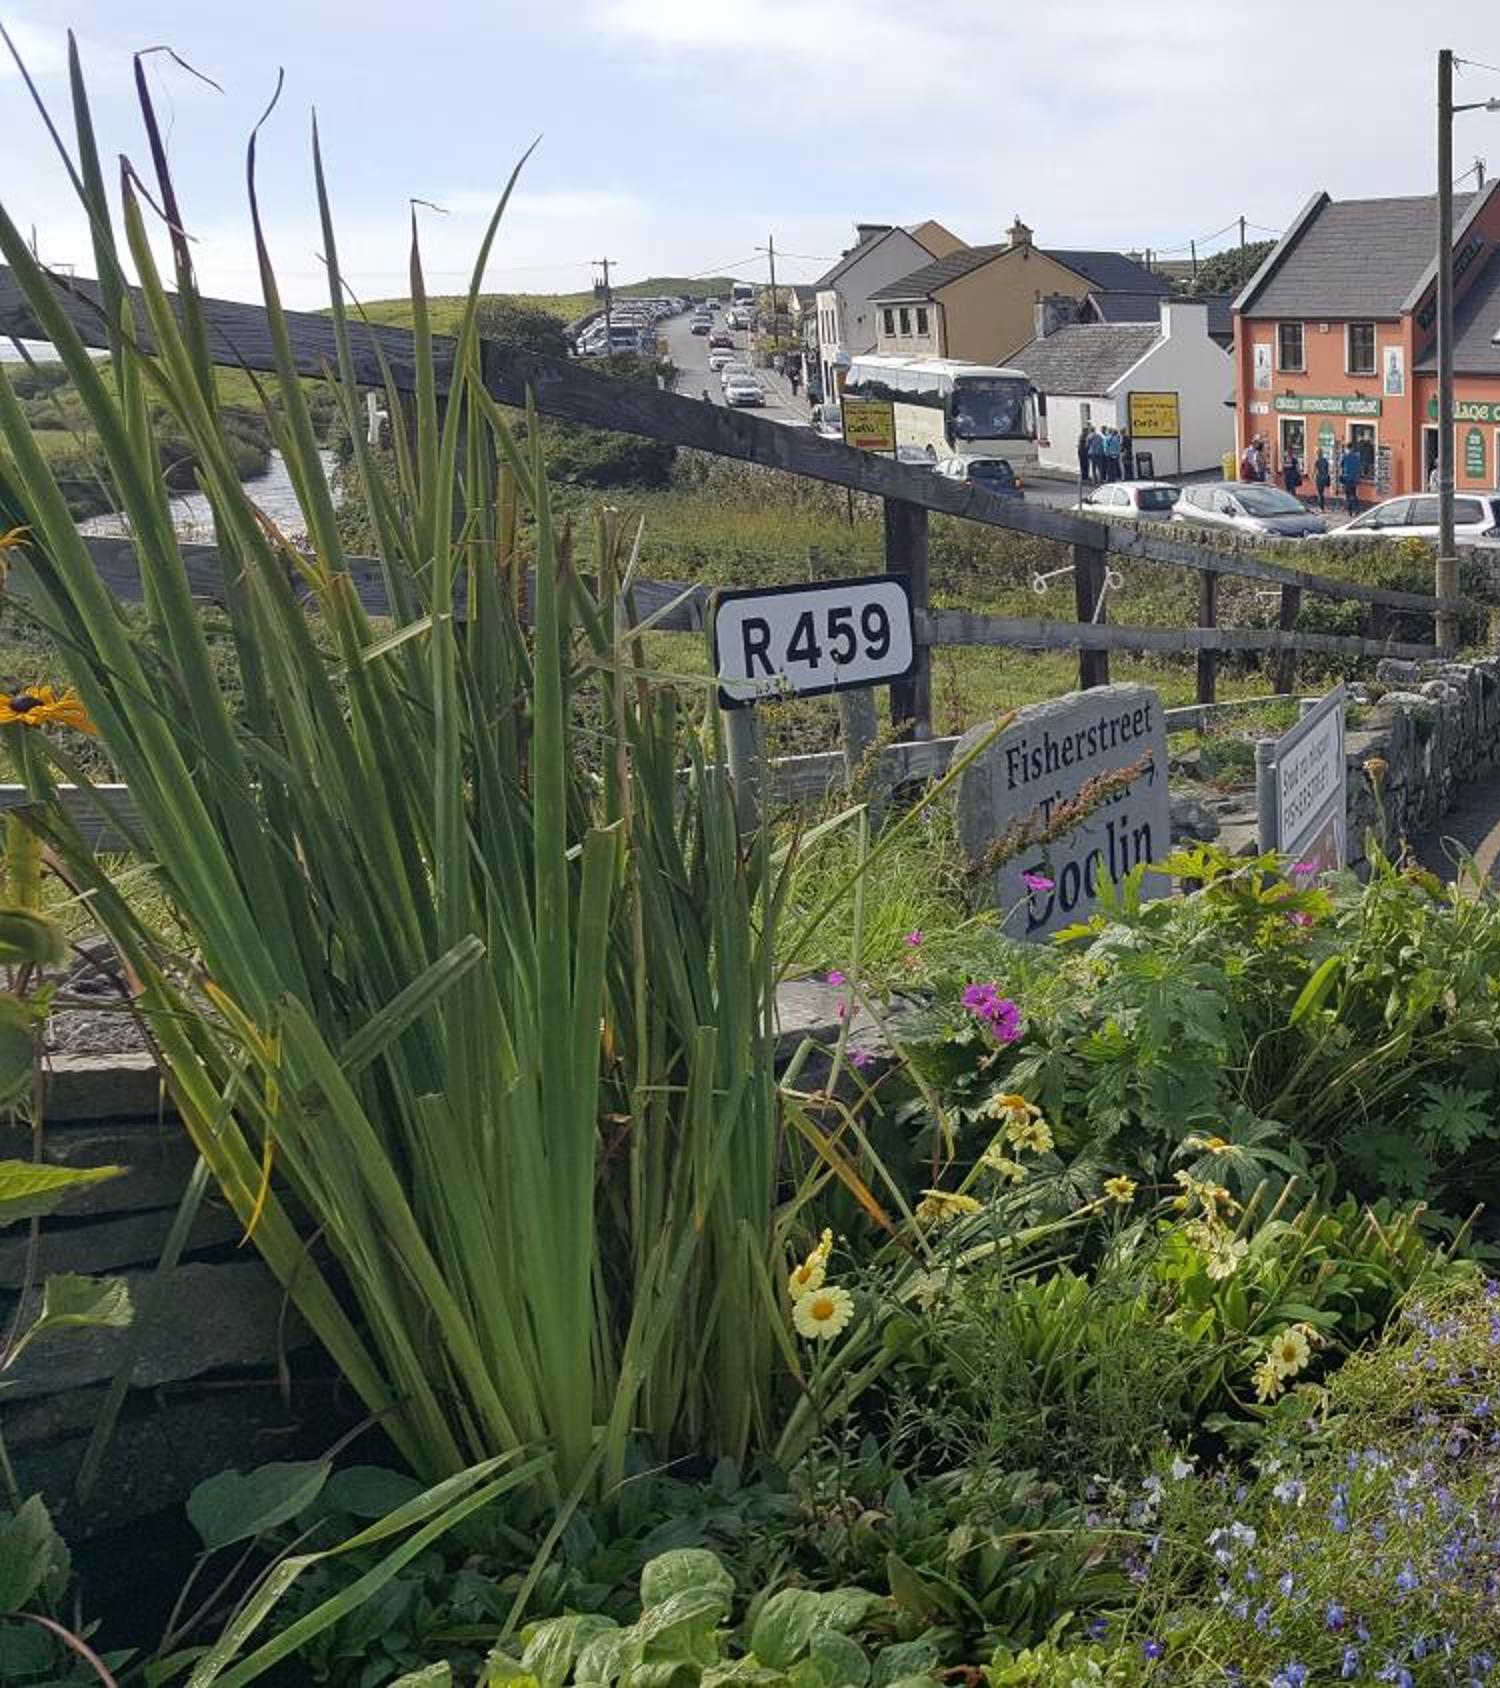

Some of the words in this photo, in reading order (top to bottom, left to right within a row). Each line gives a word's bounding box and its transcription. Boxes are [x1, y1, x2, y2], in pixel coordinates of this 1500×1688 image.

[741, 617, 775, 679] R
[786, 603, 891, 669] 459
[1005, 701, 1153, 791] Fisherstreet
[1022, 815, 1153, 935] Doolin
